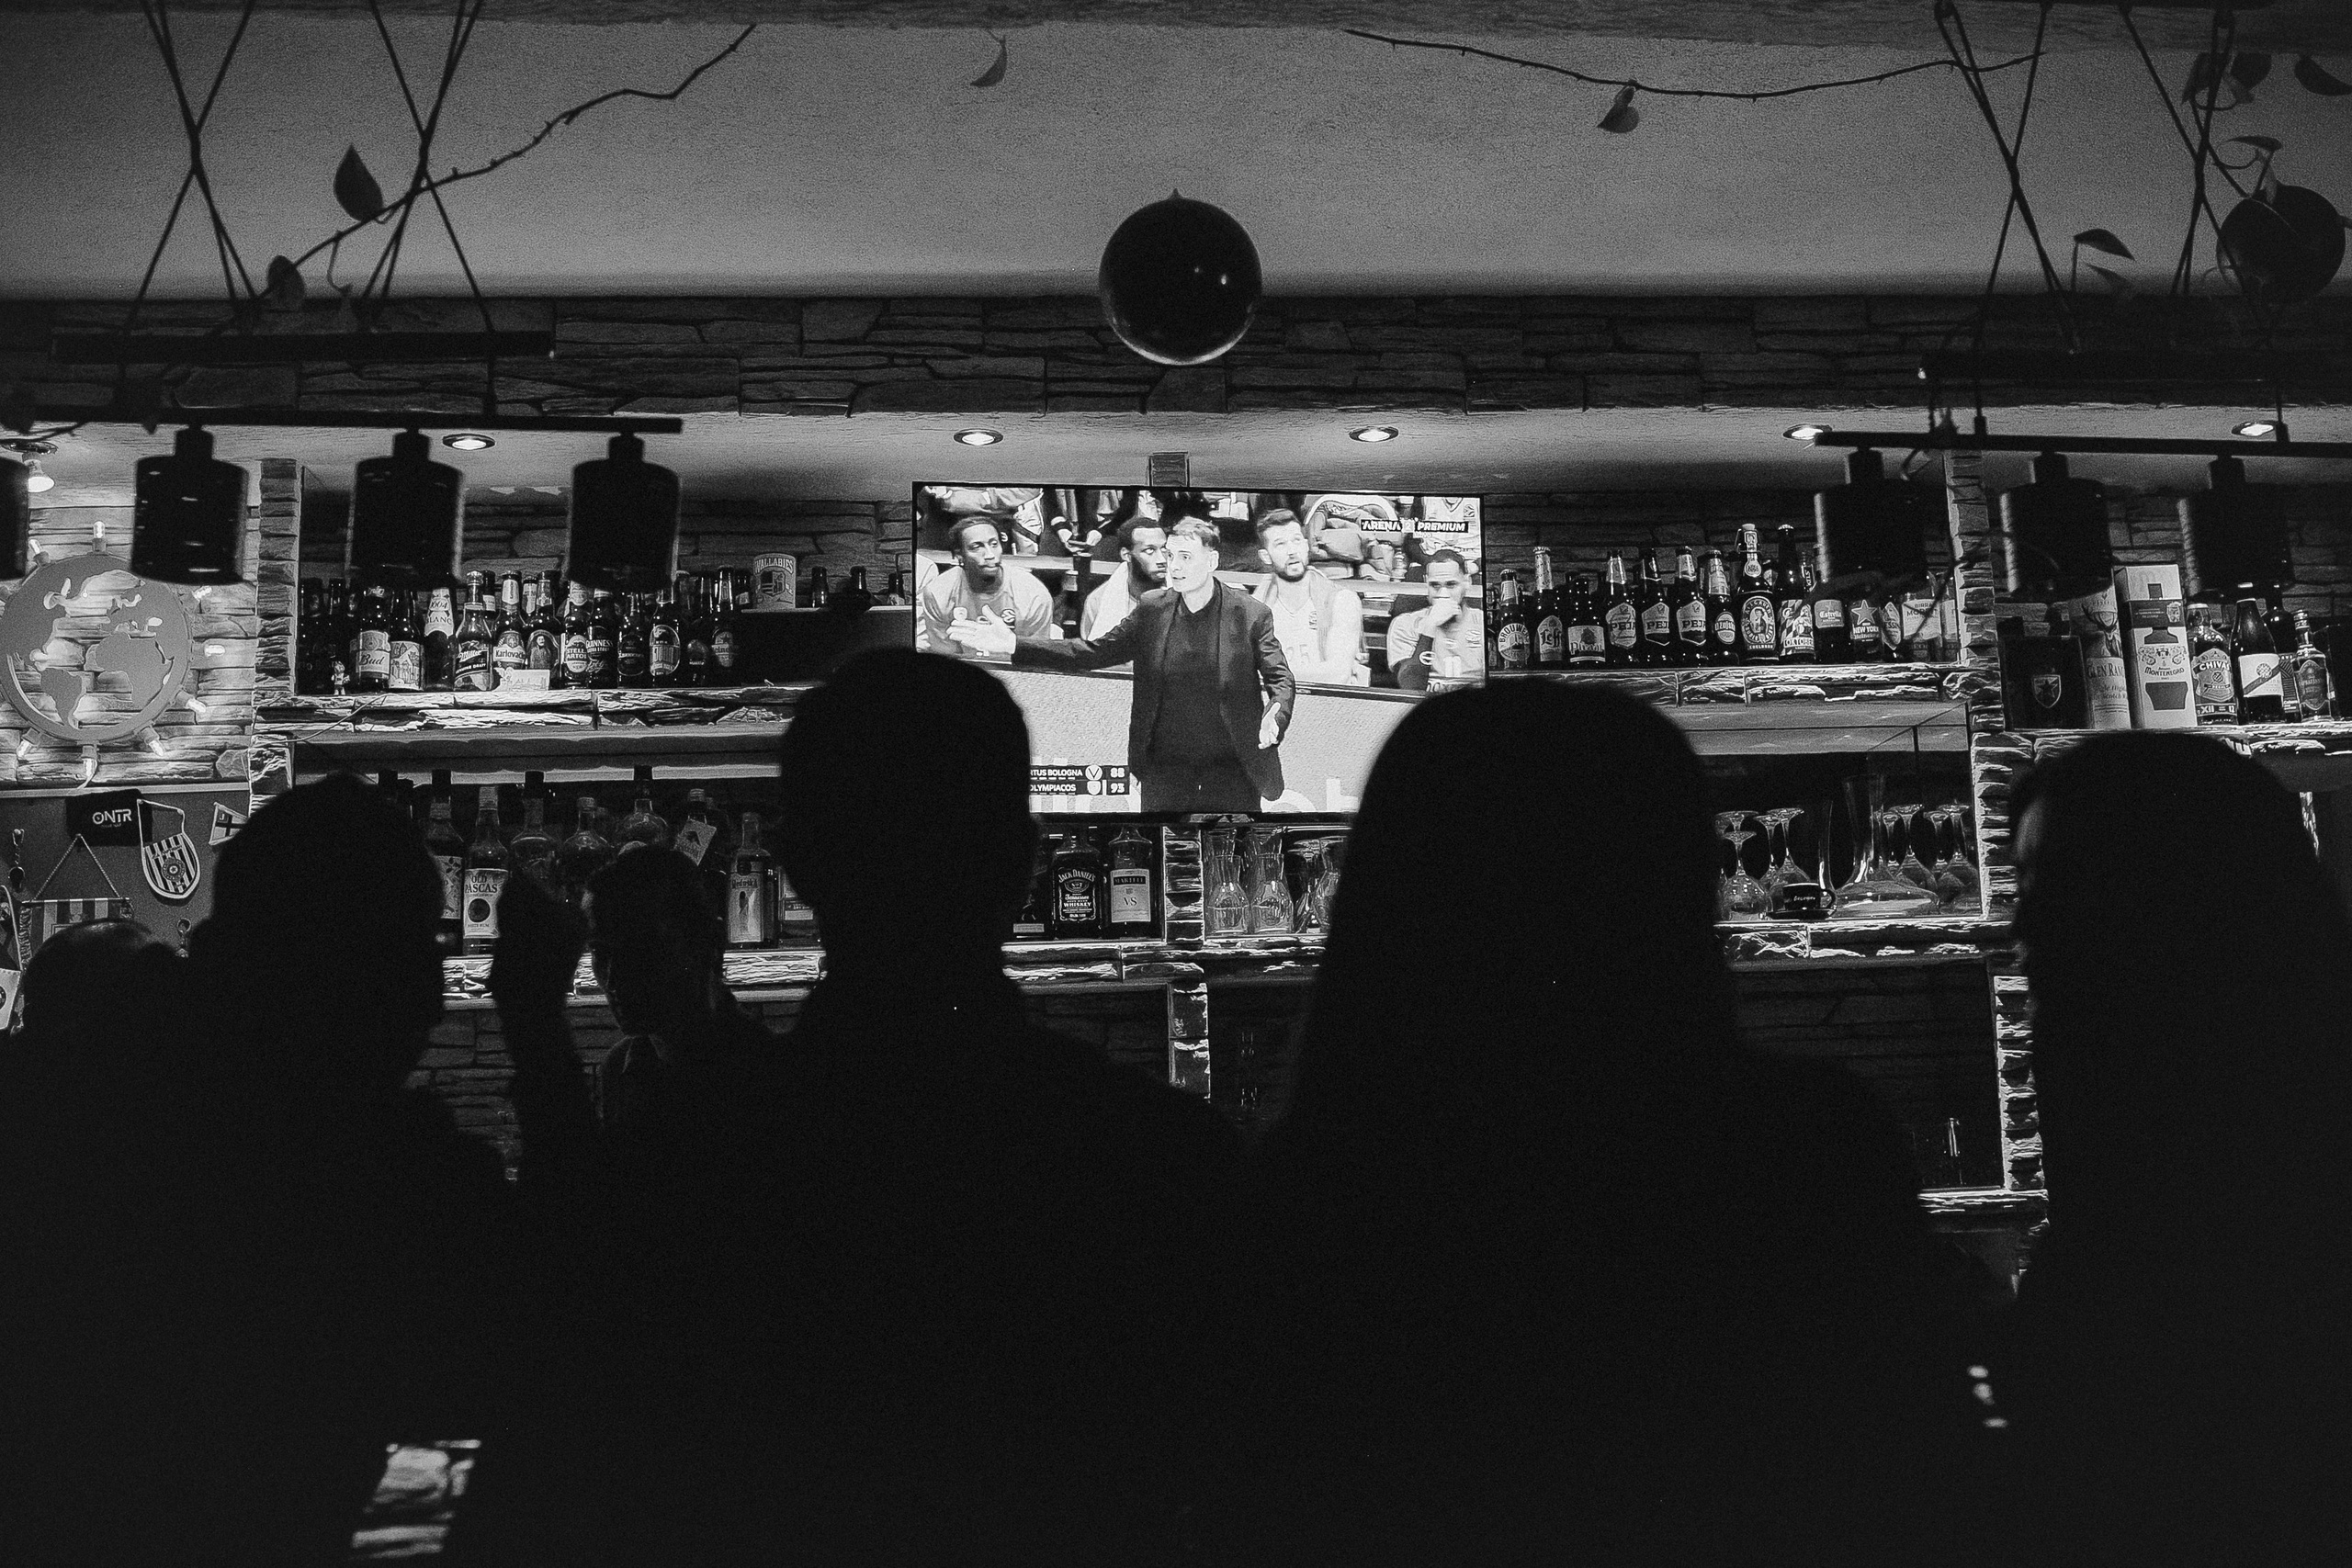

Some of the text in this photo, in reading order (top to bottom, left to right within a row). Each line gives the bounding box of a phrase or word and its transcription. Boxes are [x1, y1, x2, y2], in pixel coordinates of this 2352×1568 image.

[1362, 520, 1401, 531] ARENA
[1417, 522, 1465, 532] PREMIUM
[755, 557, 794, 575] WALLABIES
[1540, 627, 1562, 649] Leff
[360, 653, 385, 666] Bud
[2199, 660, 2230, 671] CHIVAS
[2144, 666, 2184, 677] MONTENEGRO
[1048, 769, 1083, 777] BOLOGNA
[1111, 767, 1125, 778] 88
[1111, 783, 1125, 794] 93
[471, 874, 488, 884] OLD
[1058, 872, 1073, 883] JACK
[1123, 897, 1137, 907] VS
